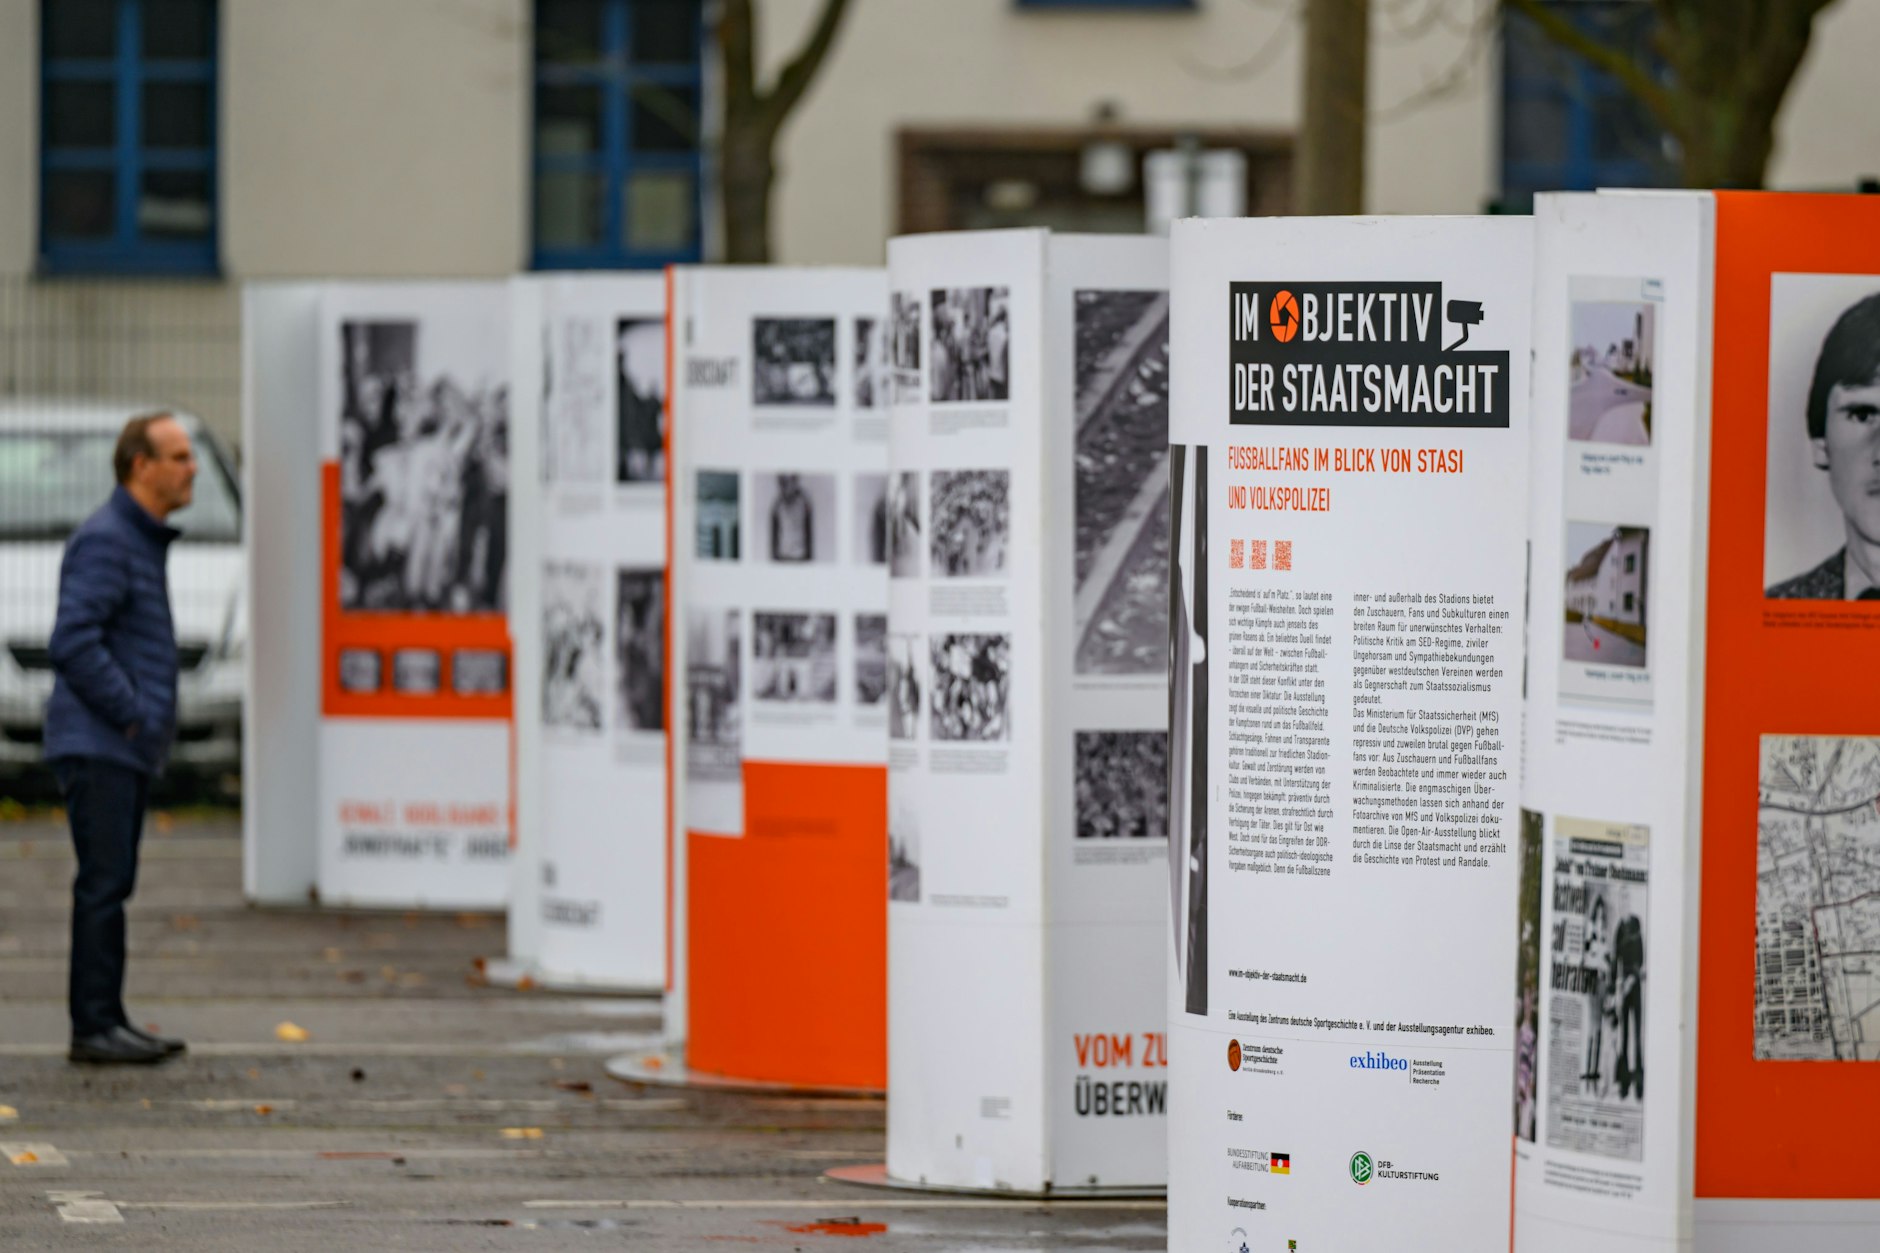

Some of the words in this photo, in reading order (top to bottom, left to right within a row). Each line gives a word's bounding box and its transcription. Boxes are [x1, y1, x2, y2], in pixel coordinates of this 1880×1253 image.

[1235, 293, 1259, 341] IM
[1235, 363, 1274, 411] DER
[1282, 364, 1498, 414] STAATSMACHT
[1228, 446, 1309, 471] FUSSBALLFANS
[1314, 449, 1328, 472] IM
[1334, 449, 1375, 472] BLICK
[1381, 449, 1411, 472] VON
[1418, 449, 1463, 473] STASI
[1228, 486, 1246, 509] UND
[1250, 486, 1330, 511] VOLKSPOLIZEI
[1354, 593, 1372, 602] inner-
[1375, 593, 1386, 602] und
[1389, 593, 1422, 603] außerhalb
[1425, 594, 1436, 603] des
[1439, 594, 1470, 604] Stadions
[1473, 594, 1494, 604] bietet
[1313, 607, 1333, 617] spielen
[1354, 607, 1364, 616] den
[1409, 608, 1424, 618] Fans
[1427, 608, 1439, 618] und
[1442, 608, 1486, 618] Subkulturen
[1489, 610, 1509, 619] einen
[1354, 622, 1375, 631] breiten
[1378, 622, 1395, 631] Raum
[1398, 622, 1407, 632] für
[1410, 623, 1462, 633] unerwünschtes
[1465, 623, 1503, 633] Verhalten:
[1353, 636, 1383, 646] Politische
[1386, 636, 1404, 646] Kritik
[1466, 638, 1488, 648] ziviler
[1353, 651, 1392, 662] Ungehorsam
[1395, 652, 1406, 661] und
[1409, 651, 1494, 665] Sympathiebekundungen
[1353, 666, 1386, 677] gegenüber
[1389, 667, 1439, 676] westdeutschen
[1442, 667, 1473, 677] Vereinen
[1476, 669, 1503, 677] werden
[1353, 680, 1362, 689] als
[1364, 680, 1407, 691] Gegnerschaft
[1426, 682, 1491, 692] Staatssozialismus
[1293, 692, 1325, 704] Ausstellung
[1353, 695, 1382, 705] gedeutet.
[1353, 708, 1364, 718] Das
[1367, 708, 1404, 719] Ministerium
[1407, 710, 1416, 719] für
[1418, 710, 1477, 721] Staatssicherheit
[1479, 711, 1499, 722] (MfS)
[1353, 723, 1365, 732] und
[1367, 723, 1376, 733] die
[1378, 723, 1408, 734] Deutsche
[1411, 724, 1452, 737] Volkspolizei
[1454, 724, 1474, 737] (DVP)
[1476, 726, 1499, 738] gehen
[1294, 735, 1330, 746] Transparente
[1353, 739, 1381, 749] repressiv
[1383, 738, 1394, 748] und
[1397, 739, 1425, 748] zuweilen
[1428, 739, 1448, 749] brutal
[1450, 741, 1472, 752] gegen
[1474, 740, 1504, 751] Fußball-
[1353, 752, 1366, 761] fans
[1383, 753, 1394, 762] Aus
[1397, 753, 1436, 763] Zuschauern
[1439, 754, 1451, 764] und
[1454, 755, 1497, 765] Fußballfans
[1353, 767, 1375, 776] werden
[1378, 767, 1418, 777] Beobachtete
[1421, 768, 1434, 778] und
[1436, 769, 1459, 778] immer
[1461, 769, 1485, 779] wieder
[1488, 770, 1507, 780] auch
[1353, 781, 1403, 792] Kriminalisierte.
[1406, 782, 1416, 792] Die
[1419, 783, 1471, 796] engmaschigen
[1474, 782, 1495, 794] Über-
[1353, 796, 1417, 808] wachungsmethoden
[1420, 798, 1442, 808] lassen
[1445, 798, 1459, 808] sich
[1462, 799, 1489, 809] anhand
[1492, 799, 1504, 809] der
[1353, 810, 1389, 820] Fotoarchive
[1405, 812, 1418, 821] MfS
[1420, 812, 1433, 822] und
[1436, 812, 1478, 825] Volkspolizei
[1481, 814, 1502, 824] doku-
[1353, 826, 1386, 835] mentieren.
[1389, 826, 1399, 835] Die
[1401, 826, 1477, 840] Open-Air-Ausstellung
[1479, 829, 1500, 838] blickt
[1353, 840, 1370, 848] durch
[1373, 840, 1382, 849] die
[1384, 840, 1402, 850] Linse
[1404, 841, 1415, 850] der
[1417, 841, 1461, 852] Staatsmacht
[1464, 843, 1477, 852] und
[1480, 843, 1506, 853] erzählt
[1353, 854, 1362, 863] die
[1364, 854, 1399, 864] Geschichte
[1416, 856, 1440, 866] Protest
[1443, 857, 1456, 866] und
[1459, 857, 1490, 868] Randale.
[1268, 1014, 1289, 1025] Zentrums
[1290, 1016, 1312, 1026] deutsche
[1314, 1017, 1357, 1030] Sportgeschichte
[1373, 1022, 1384, 1031] und
[1386, 1022, 1395, 1031] der
[1398, 1022, 1464, 1036] Ausstellungsagentur
[1466, 1026, 1494, 1035] exhibeo.
[1074, 1033, 1132, 1067] VOM
[1350, 1052, 1407, 1071] exhibeo
[1413, 1060, 1442, 1068] Ausstellung
[1228, 1148, 1268, 1160] BUNDESSTIFTUNG
[1233, 1161, 1268, 1172] AUFARBEITUNG
[1378, 1171, 1439, 1180] KULTURSTIFTUNG
